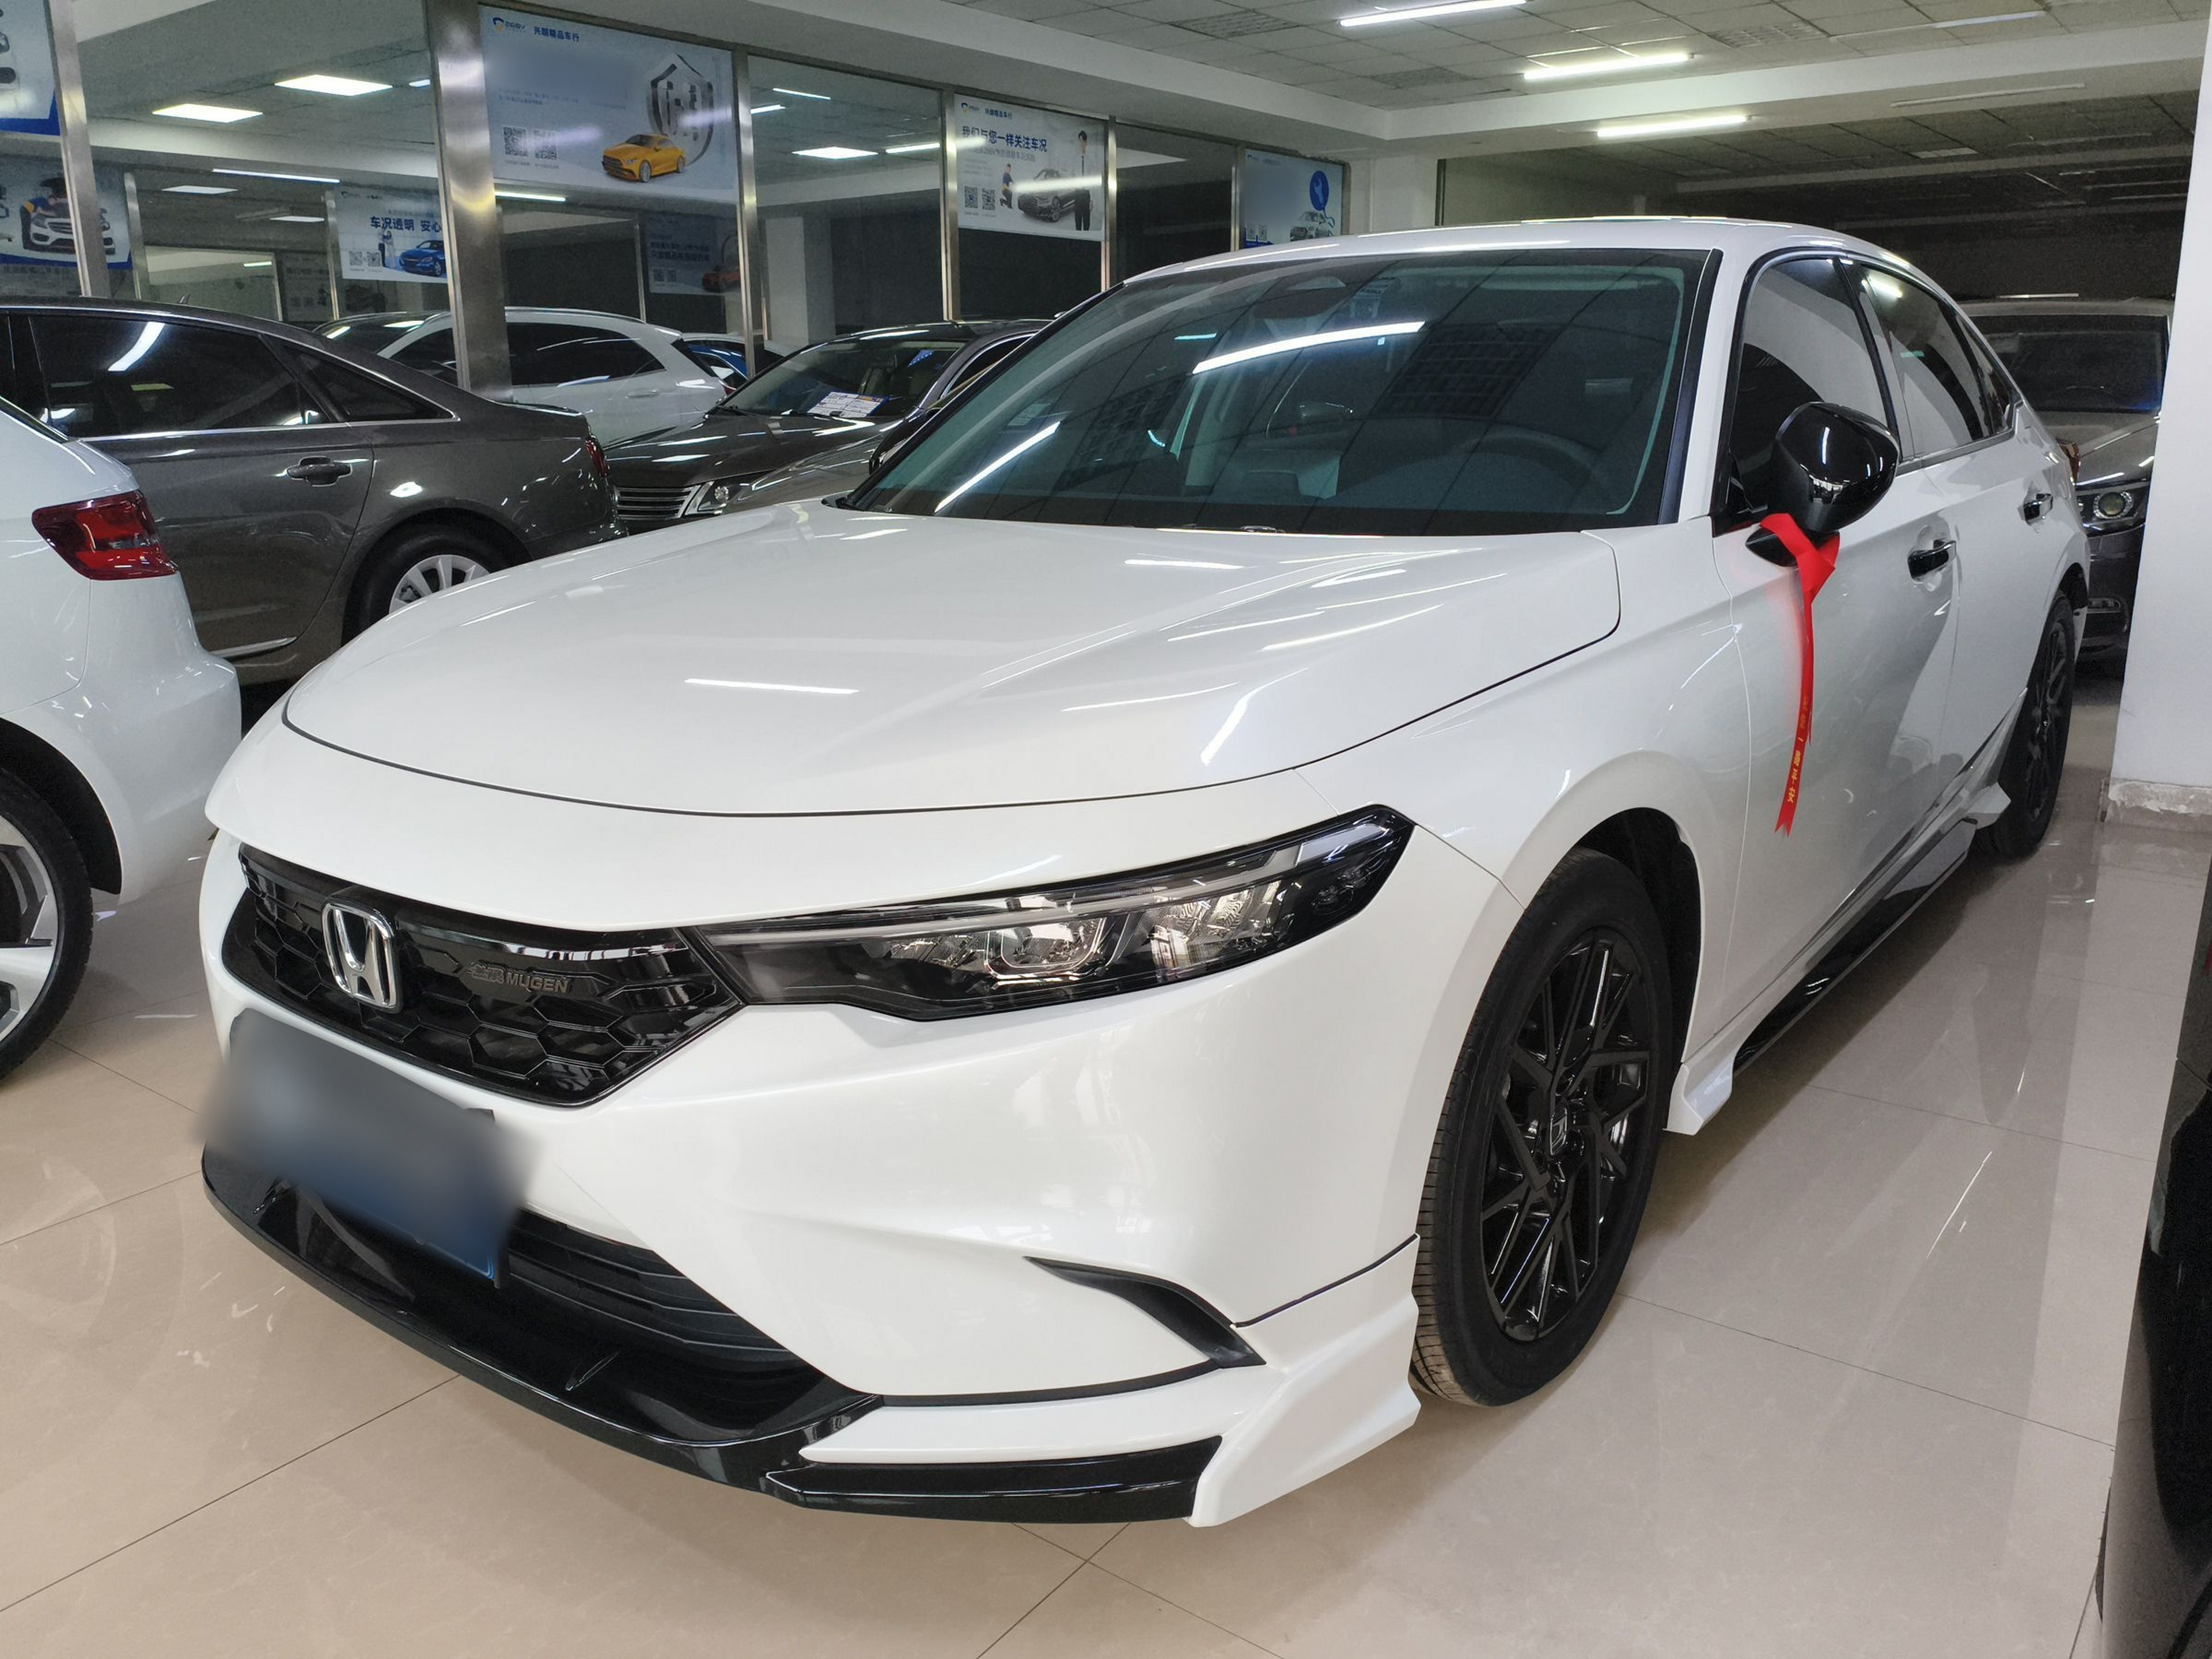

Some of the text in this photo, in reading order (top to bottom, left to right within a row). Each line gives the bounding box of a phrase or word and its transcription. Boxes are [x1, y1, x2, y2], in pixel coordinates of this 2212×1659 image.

[962, 126, 1047, 153] 我们与您一样关注车况
[370, 216, 442, 232] 车况透明 安心
[506, 972, 570, 993] MUGEN
